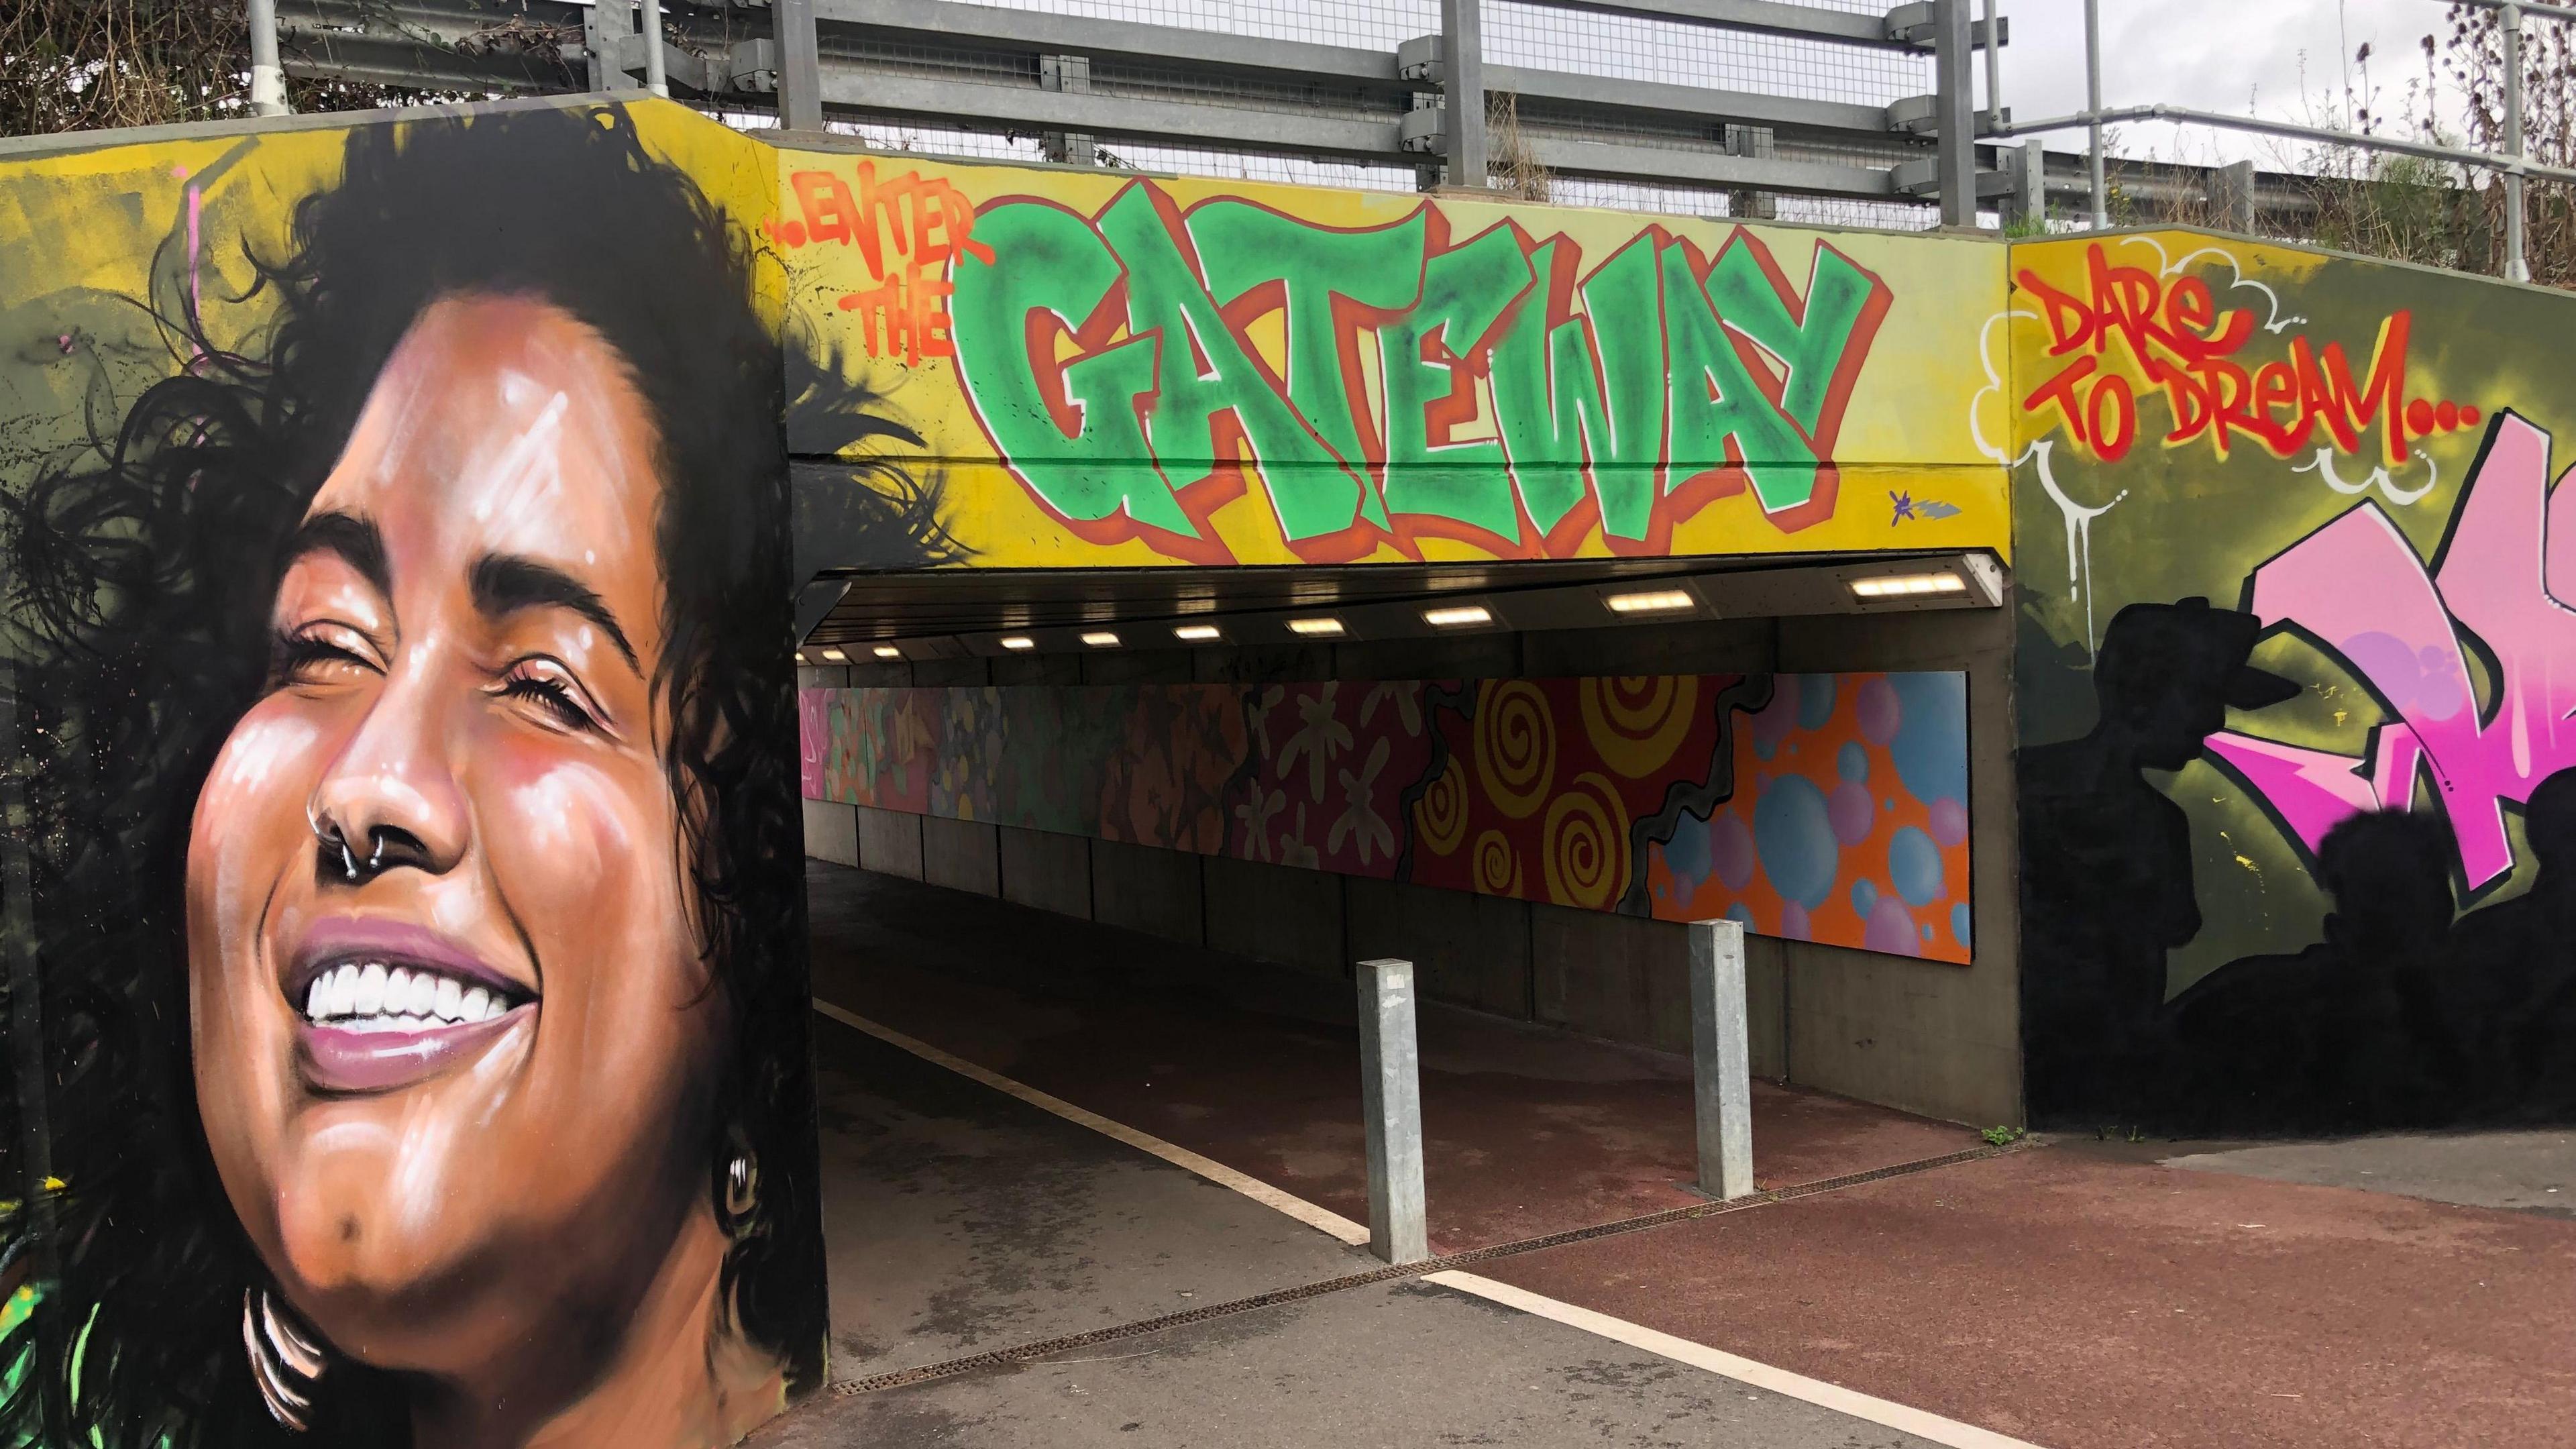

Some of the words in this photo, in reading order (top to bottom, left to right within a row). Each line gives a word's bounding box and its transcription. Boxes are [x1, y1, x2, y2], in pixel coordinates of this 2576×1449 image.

[838, 262, 955, 368] THE
[941, 176, 1894, 565] GATEWAY
[2023, 355, 2136, 464] TO
